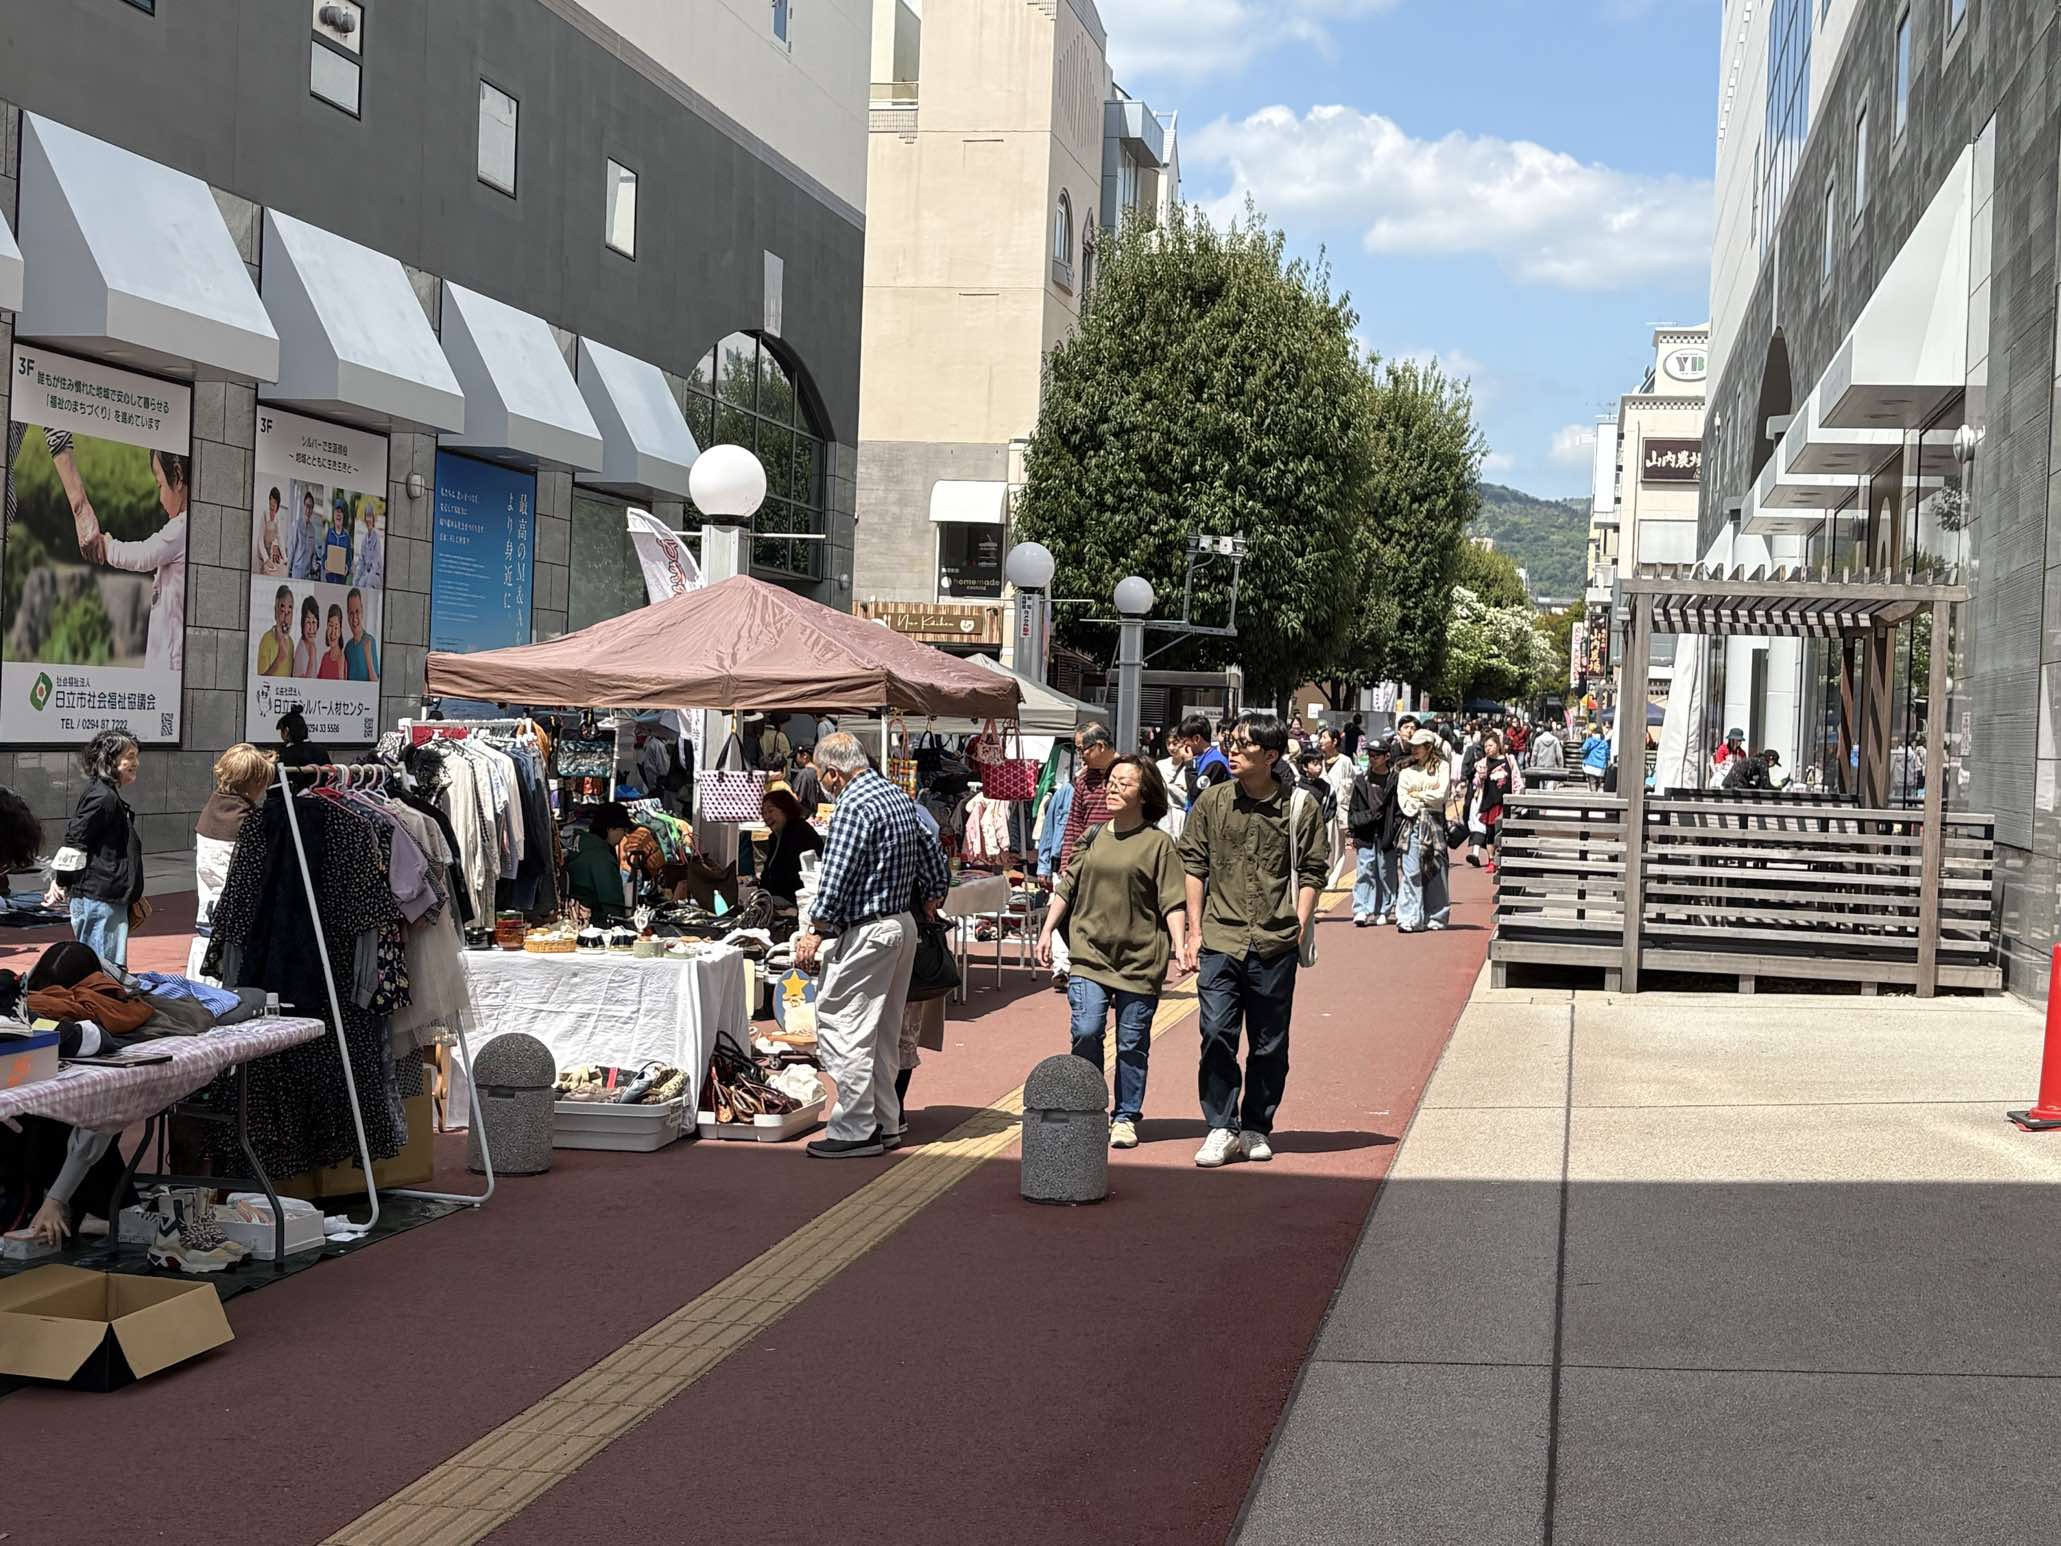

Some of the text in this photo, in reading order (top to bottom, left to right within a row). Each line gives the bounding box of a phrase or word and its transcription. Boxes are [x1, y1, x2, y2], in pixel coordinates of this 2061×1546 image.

[18, 357, 35, 376] 3F
[1676, 356, 1705, 372] YB
[37, 371, 170, 414] 誰もが住み慣れた地域で安心して暮らせる
[260, 417, 273, 433] 3F
[55, 690, 156, 710] 日立市社会福祉協議会
[274, 699, 370, 716] 日立ルバー人材センター
[60, 718, 75, 730] TEL
[81, 719, 99, 730] 0294
